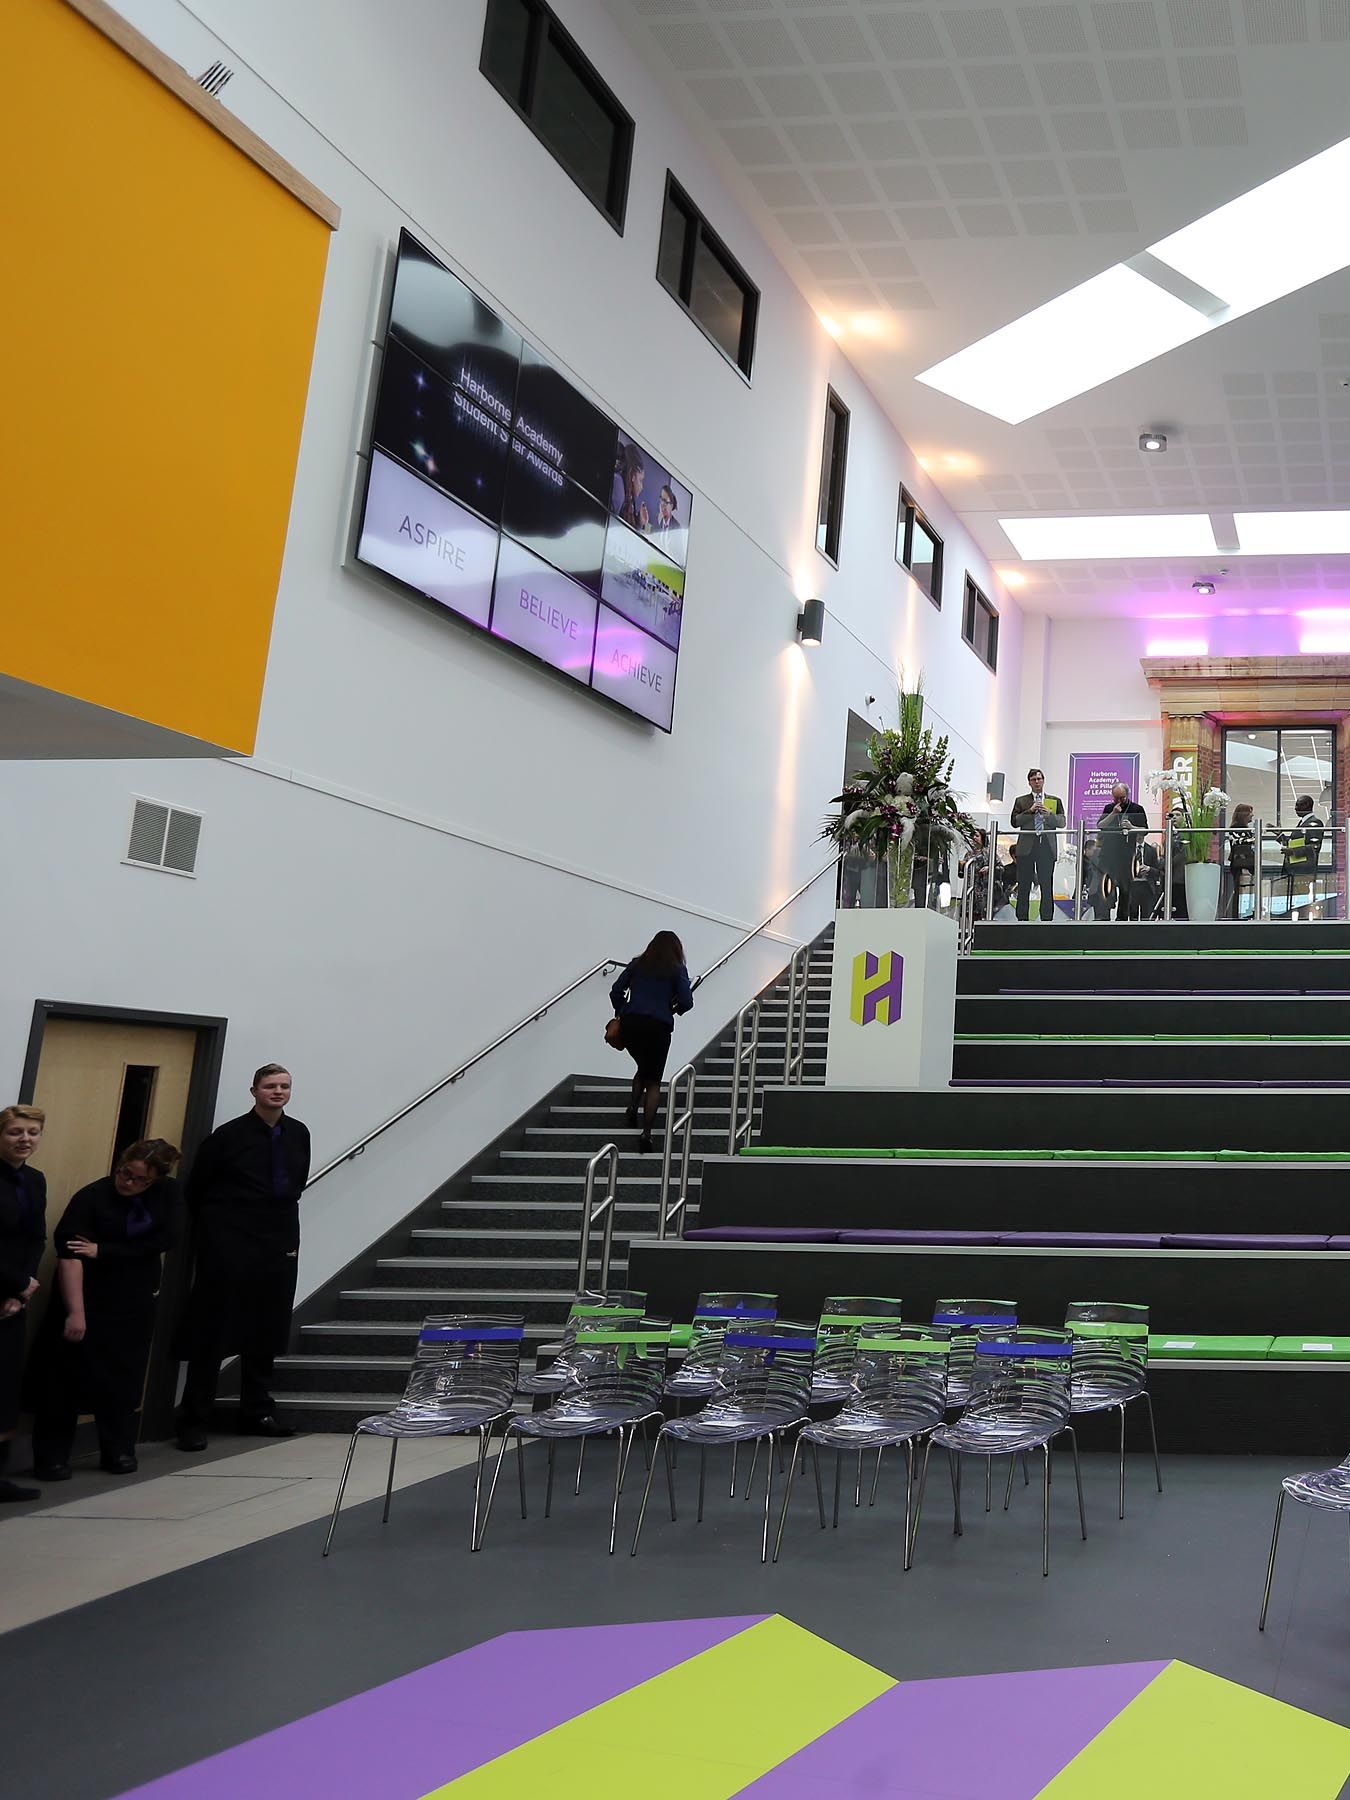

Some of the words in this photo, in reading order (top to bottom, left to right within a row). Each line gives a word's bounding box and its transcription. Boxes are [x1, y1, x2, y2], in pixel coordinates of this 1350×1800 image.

[452, 382, 499, 435] Student
[526, 443, 567, 487] Awards
[460, 367, 512, 421] Harborne
[516, 416, 564, 468] Academy
[398, 514, 467, 571] ASPIRE
[519, 588, 578, 641] BELIEVE
[611, 648, 663, 693] ACHIEVE
